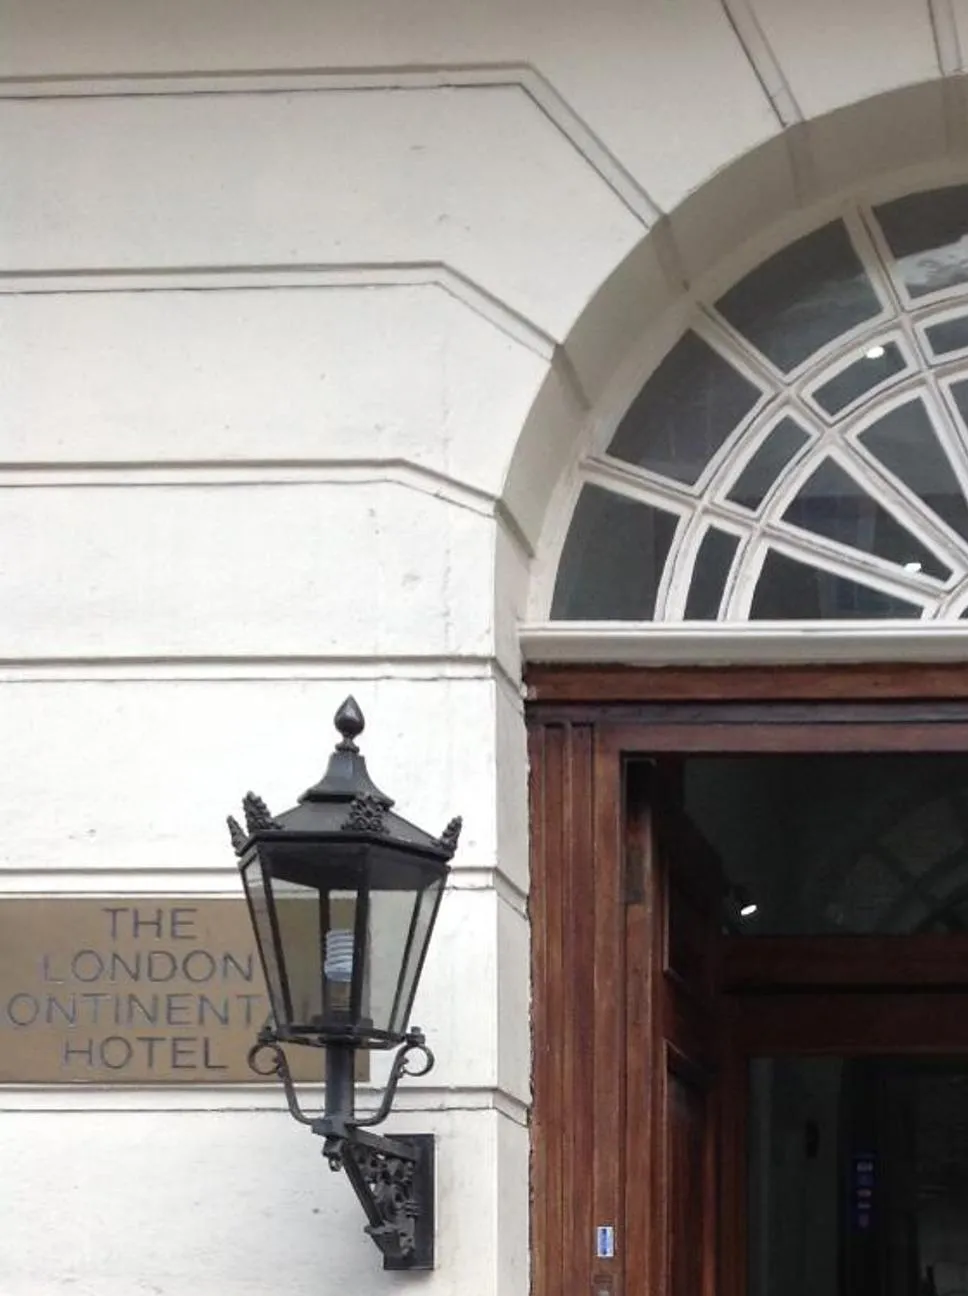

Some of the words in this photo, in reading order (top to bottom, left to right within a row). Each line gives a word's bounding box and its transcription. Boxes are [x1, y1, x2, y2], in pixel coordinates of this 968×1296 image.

[102, 907, 198, 939] THE
[43, 949, 254, 983] LONDON
[5, 992, 276, 1028] ONTINENT
[65, 1035, 229, 1069] HOTEL
